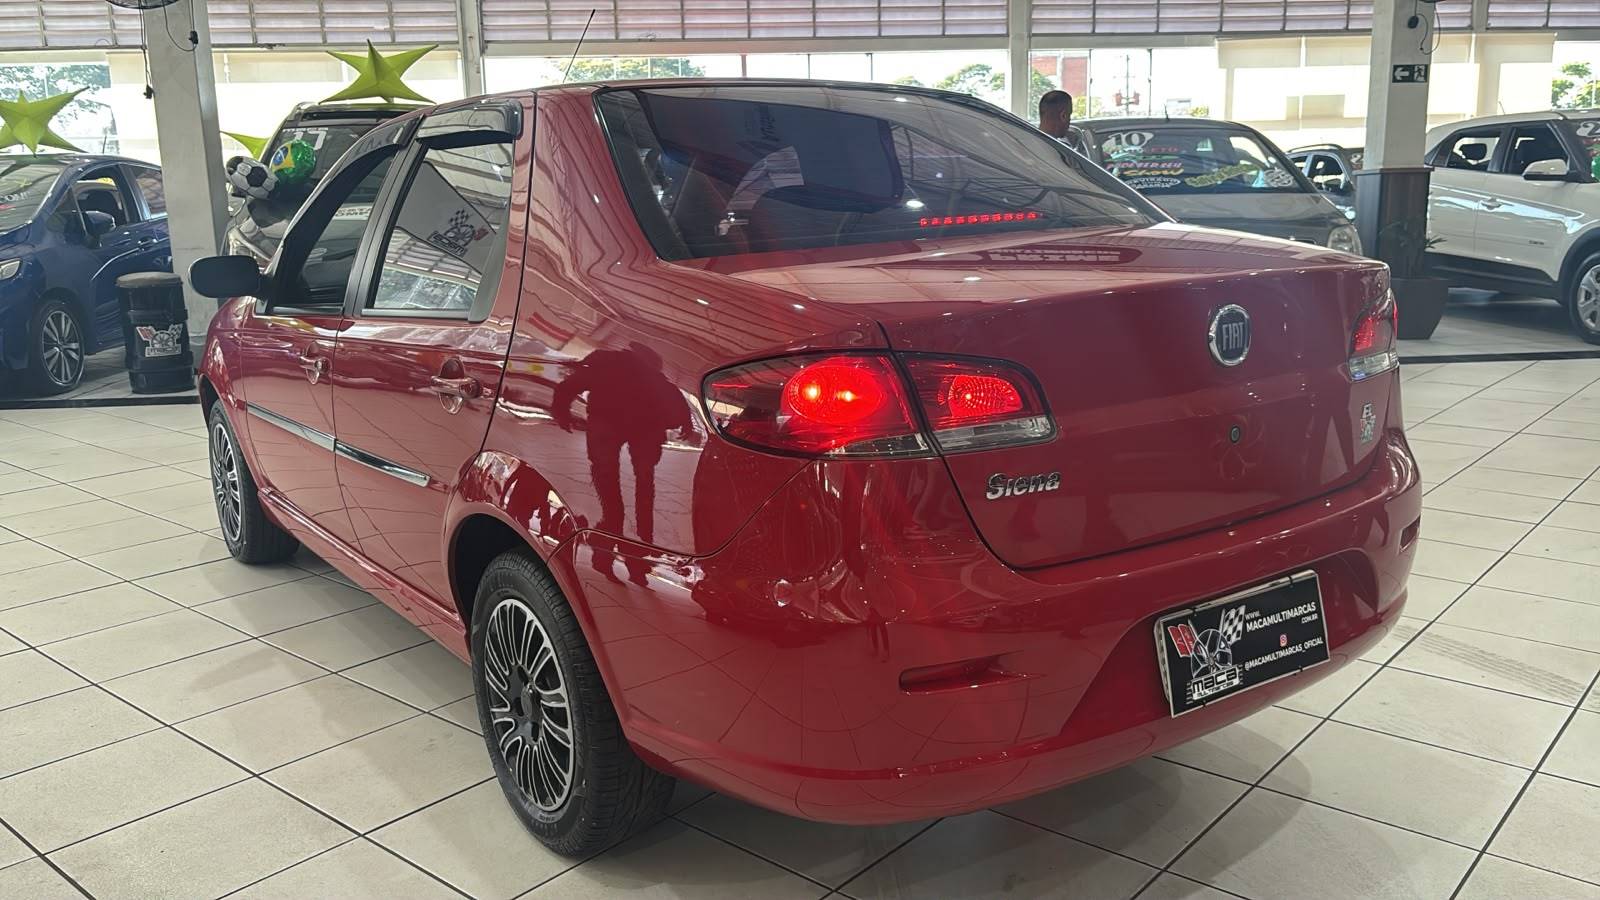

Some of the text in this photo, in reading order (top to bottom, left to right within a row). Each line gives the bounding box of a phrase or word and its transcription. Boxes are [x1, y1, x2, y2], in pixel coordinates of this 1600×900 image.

[1109, 132, 1147, 147] 10
[1222, 322, 1245, 350] FIAT
[986, 472, 1060, 500] Siena
[1246, 601, 1317, 632] MACAMULTIMARCAS
[1245, 637, 1324, 671] @MACAMULTIMARCAS_OFICIAL
